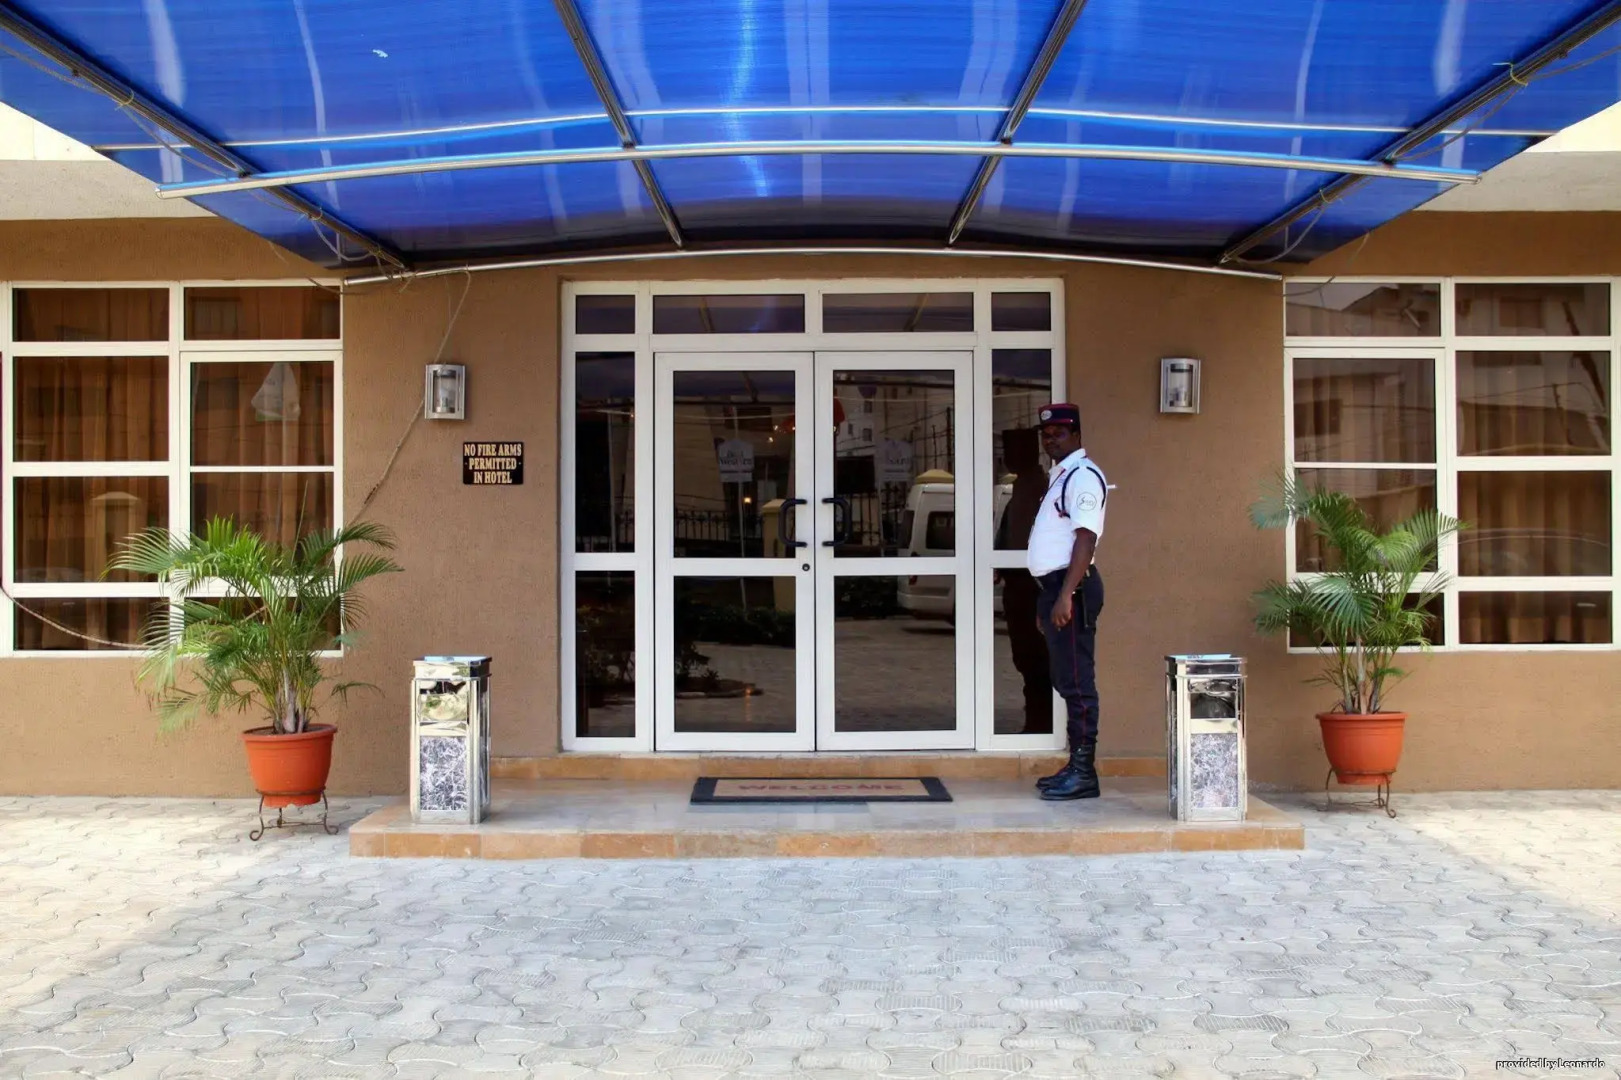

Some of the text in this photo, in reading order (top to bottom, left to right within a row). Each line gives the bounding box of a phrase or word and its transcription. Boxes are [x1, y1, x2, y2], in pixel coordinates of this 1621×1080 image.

[464, 443, 522, 457] NO FIRE ARMS
[468, 457, 517, 470] PERMITTED
[473, 471, 513, 484] IN HOTEL
